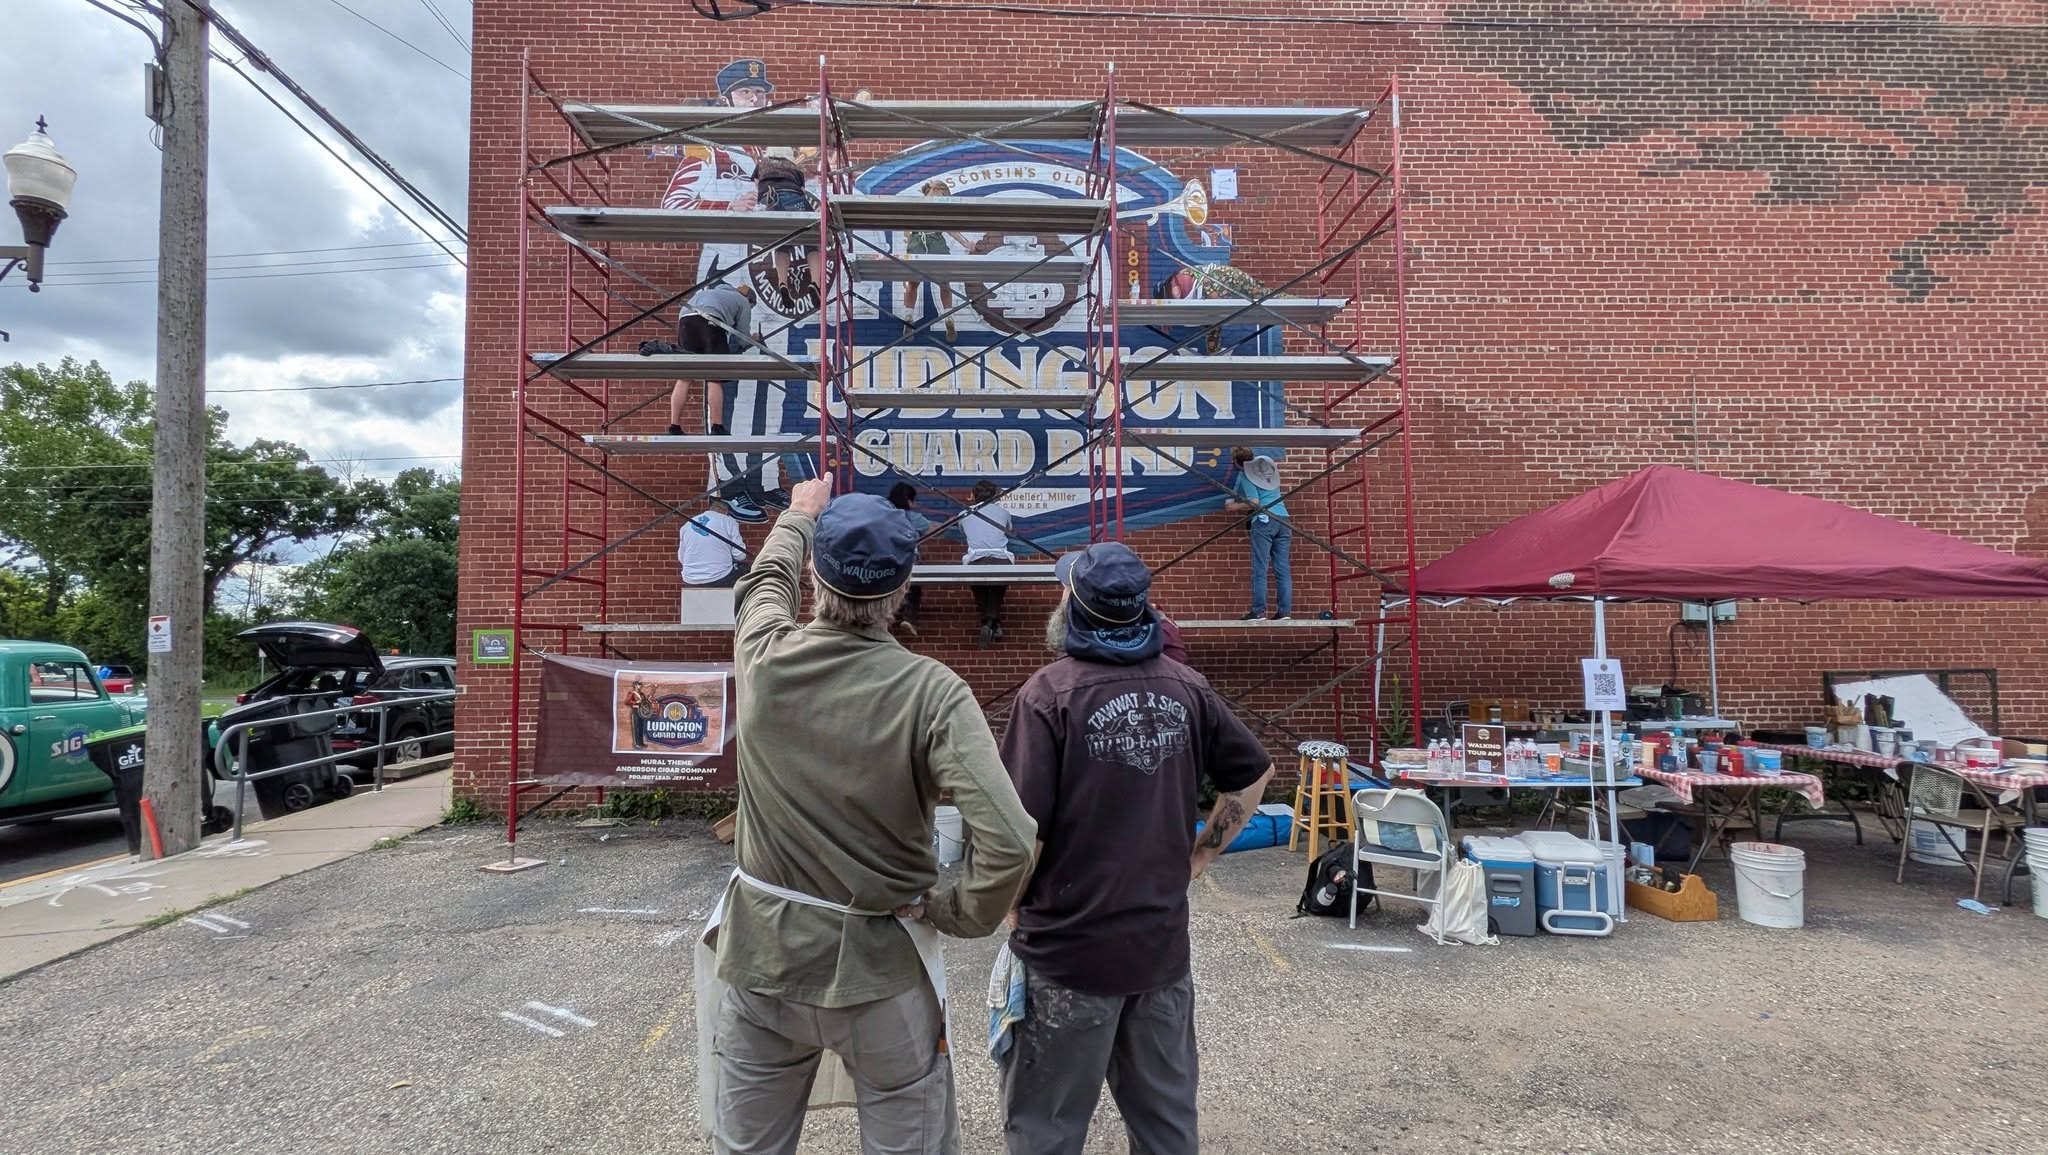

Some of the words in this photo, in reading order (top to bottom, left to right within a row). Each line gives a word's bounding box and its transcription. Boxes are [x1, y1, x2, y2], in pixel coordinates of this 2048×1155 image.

[947, 167, 1036, 189] SCONSIN'S
[803, 338, 1236, 420] LUDINGTON
[852, 428, 1035, 477] GUARD
[1046, 428, 1194, 476] BAND
[1048, 492, 1077, 502] Miller
[1003, 502, 1048, 510] OUNDER
[842, 564, 896, 584] WALLDOGS
[1088, 692, 1156, 730] TAWWATR
[1159, 695, 1187, 722] SIGN
[646, 720, 703, 732] LUDINGTON
[1467, 742, 1502, 750] WALKING
[118, 751, 145, 766] GFL
[1466, 749, 1487, 757] TOUR
[640, 758, 666, 766] MURAL
